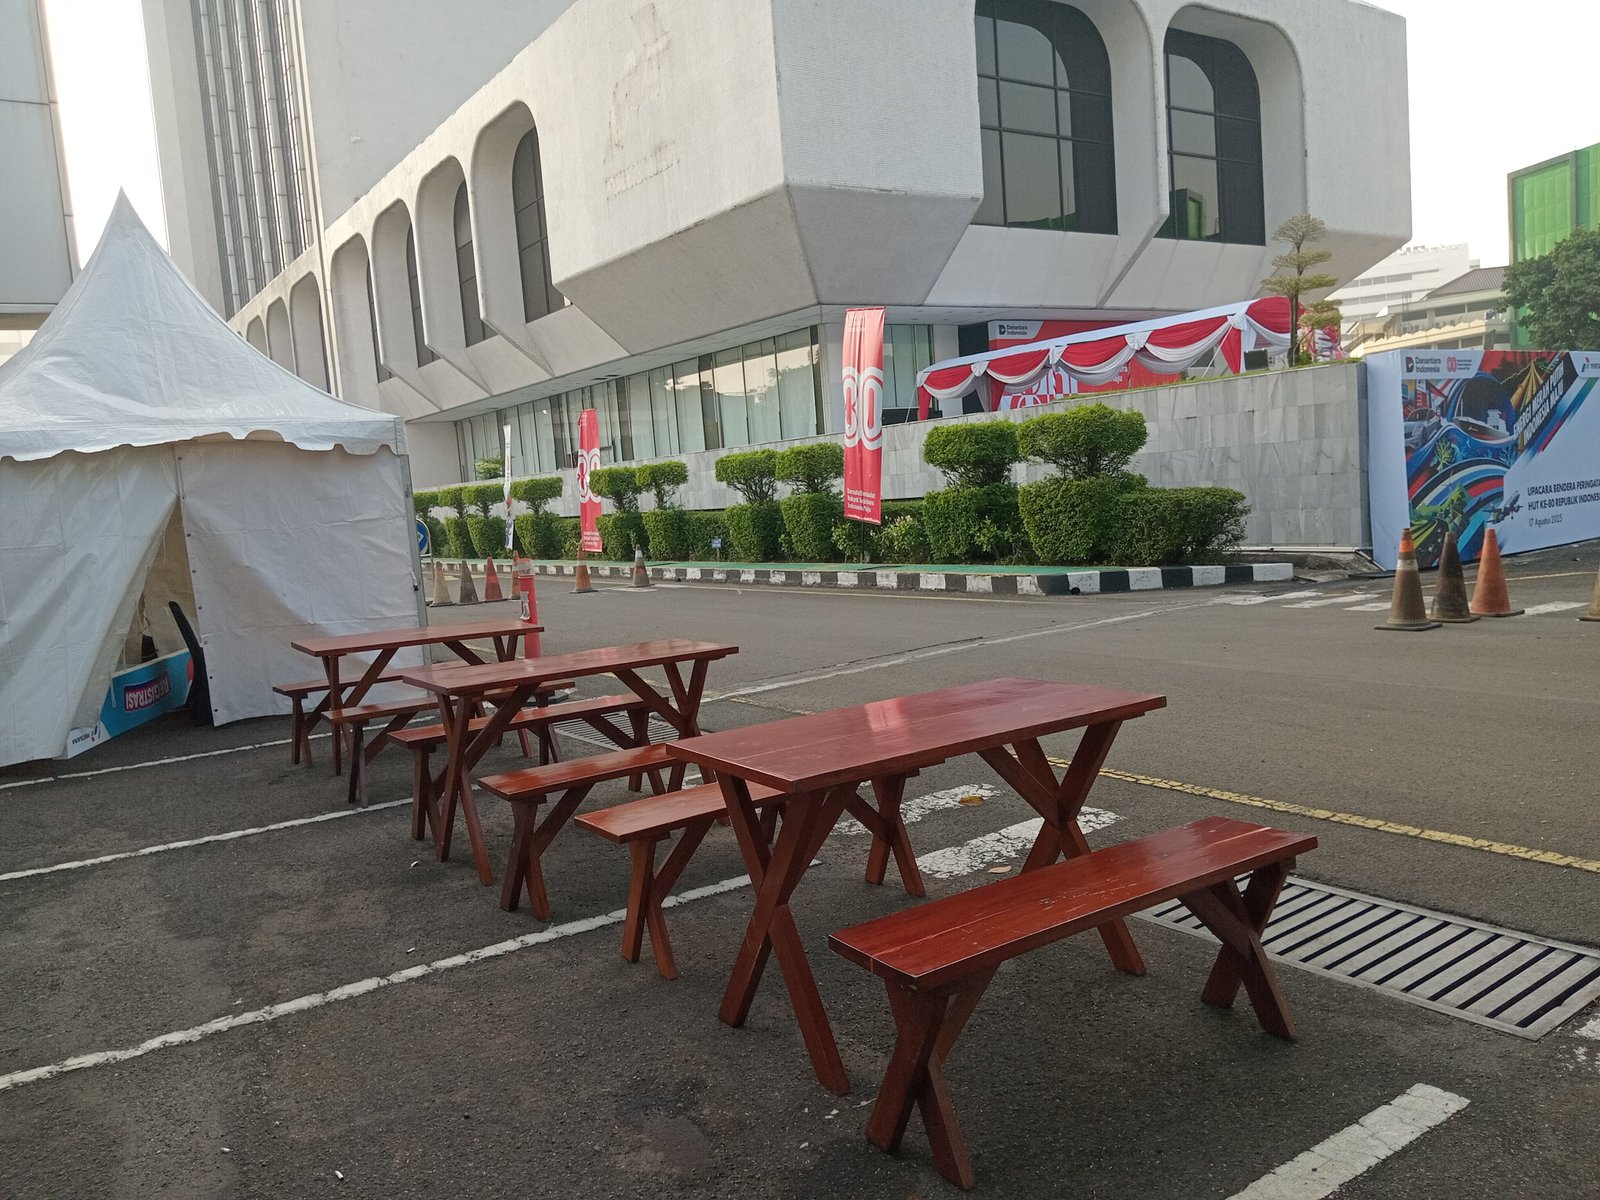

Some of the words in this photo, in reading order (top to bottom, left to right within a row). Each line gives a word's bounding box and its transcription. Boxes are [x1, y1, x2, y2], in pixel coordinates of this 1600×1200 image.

[1415, 357, 1441, 365] Danantara
[842, 367, 883, 451] 80
[1523, 398, 1550, 446] INDONESIA
[1528, 485, 1552, 496] UPACARA
[1553, 482, 1576, 493] BENDERA
[1528, 500, 1539, 510] HUT
[1540, 499, 1555, 509] KE-80
[1555, 496, 1578, 507] REPUBLIK
[125, 677, 170, 710] REGISTRASI
